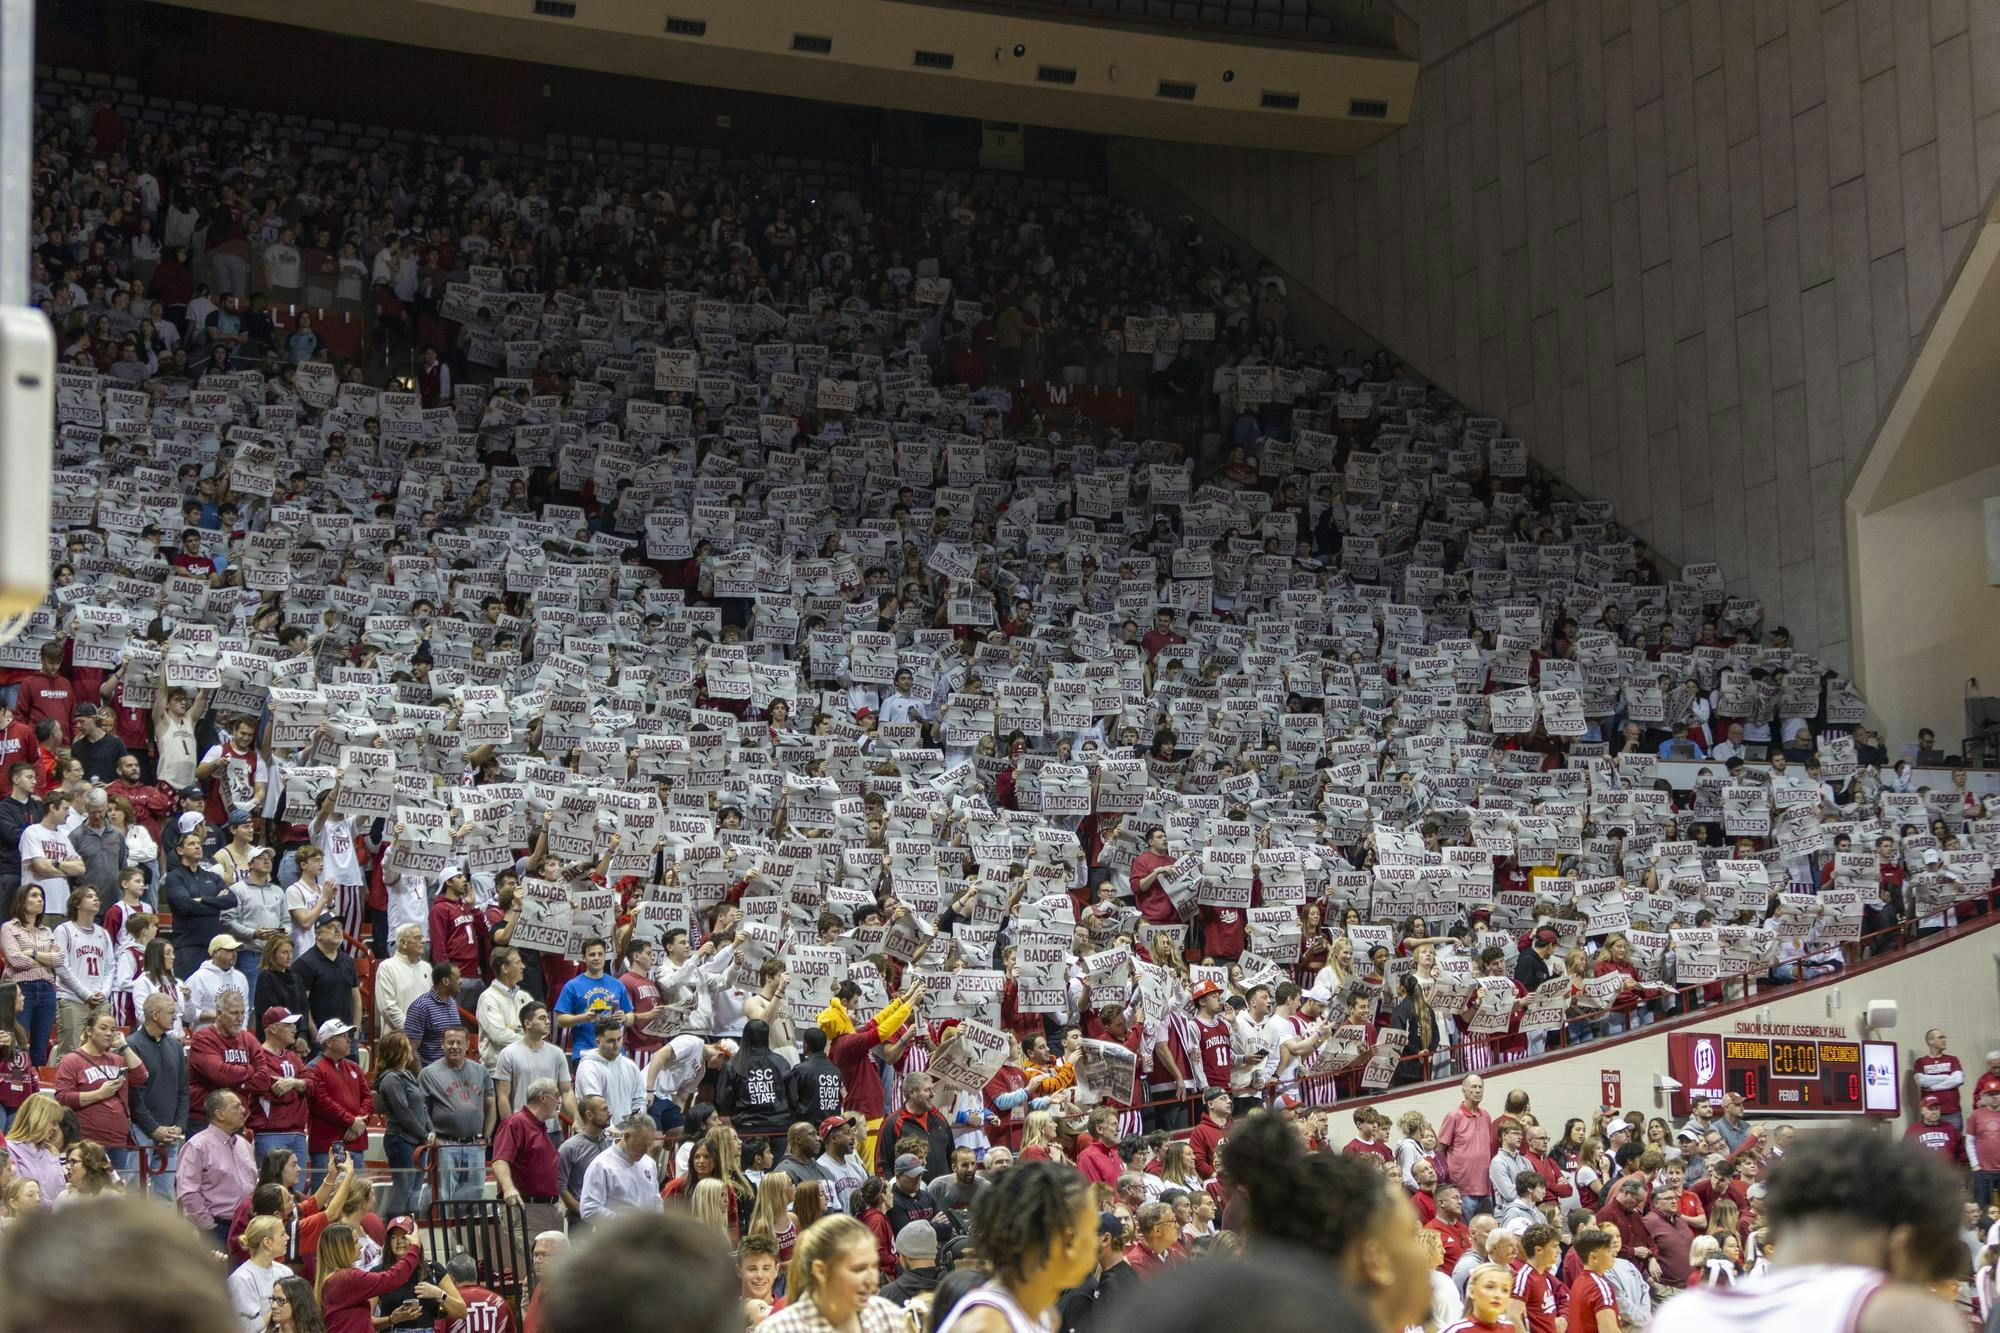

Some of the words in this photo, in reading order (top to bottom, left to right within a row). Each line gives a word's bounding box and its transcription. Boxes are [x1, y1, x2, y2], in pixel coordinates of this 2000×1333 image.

[1050, 387, 1067, 403] M
[651, 517, 684, 527] BADGER
[797, 566, 828, 577] BADGER
[117, 582, 155, 597] BADGER
[292, 588, 325, 600] BADGER
[334, 591, 368, 606] BADGER
[1287, 593, 1317, 603] BADGER
[83, 610, 123, 624] BADGER
[542, 610, 575, 623] BADGER
[682, 610, 715, 622] BADGER
[372, 619, 410, 631] BADGER
[857, 635, 891, 645] BADGER
[711, 648, 743, 660] BADGER
[231, 656, 268, 672] BADGER
[169, 666, 217, 681] BADGERS
[854, 666, 894, 678] BADGERS
[710, 681, 749, 693] BADGERS
[1004, 685, 1038, 696] BADGER
[1054, 682, 1086, 694] BADGER
[551, 701, 586, 713] BADGER
[955, 698, 989, 708] BADGER
[404, 708, 441, 720] BADGER
[1001, 718, 1041, 730] BADGERS
[1052, 714, 1090, 727] BADGERS
[1285, 717, 1318, 727] BADGER
[884, 726, 915, 737] BADGER
[587, 740, 621, 752] BADGER
[645, 739, 682, 750] BADGER
[350, 751, 389, 766] BADGER
[901, 752, 937, 761] BADGER
[1107, 762, 1141, 772] BADGER
[525, 767, 565, 784] BADGER
[938, 765, 974, 785] BADGER
[1438, 777, 1469, 788] BADGER
[674, 793, 704, 807] BADGER
[1729, 789, 1762, 800] BADGER
[338, 793, 390, 811] BADGERS
[561, 797, 596, 813] BADGER
[1045, 797, 1088, 809] BADGERS
[1329, 797, 1362, 808] BADGER
[789, 807, 834, 823] BADGERS
[894, 807, 926, 819] BADGER
[406, 811, 443, 828] BADGER
[624, 813, 654, 828] BADGER
[1727, 819, 1767, 831] BADGERS
[670, 820, 706, 833] BADGER
[1218, 825, 1249, 836] BADGER
[1039, 832, 1073, 843] BADGER
[550, 836, 592, 855] BADGERS
[897, 843, 931, 855] BADGER
[1660, 844, 1693, 856] BADGER
[684, 847, 720, 860] BADGER
[778, 846, 812, 859] BADGER
[1210, 852, 1246, 864] BADGER
[1259, 852, 1296, 863] BADGER
[1450, 851, 1486, 863] BADGER
[1950, 852, 1984, 864] BADGER
[394, 853, 445, 872] BADGERS
[1842, 855, 1874, 867] BADGER
[1381, 869, 1415, 880] BADGER
[1337, 876, 1367, 887] BADGER
[1541, 881, 1572, 892] BADGER
[1582, 879, 1616, 894] BADGER
[831, 890, 868, 903] BADGER
[1201, 888, 1248, 902] BADGERS
[1500, 894, 1536, 908] BADGER
[1824, 893, 1856, 904] BADGER
[581, 895, 612, 910] BADGER
[747, 901, 777, 916] BADGER
[1418, 901, 1455, 914] BADGERS
[645, 907, 682, 921] BADGER
[1255, 911, 1292, 922] BADGER
[465, 925, 474, 944] 1
[514, 925, 567, 947] BADGERS
[1353, 929, 1387, 940] BADGER
[1679, 932, 1713, 942] BADGER
[1024, 950, 1062, 962] BADGER
[1092, 951, 1126, 970] BADGER
[87, 957, 99, 976] 11
[792, 960, 829, 977] BADGER
[1678, 965, 1717, 978] BADGERS
[1018, 990, 1065, 1005] BADGERS
[1523, 1008, 1562, 1025] BADGERS
[1737, 1022, 1761, 1034] SIMON
[1763, 1024, 1789, 1036] SKJODT
[1792, 1025, 1827, 1037] ASSEMBLY
[1829, 1027, 1845, 1038] HALL
[967, 1025, 1004, 1050] BADGER
[1216, 1047, 1228, 1066] 11
[1727, 1042, 1768, 1059] INDIANA
[1774, 1045, 1816, 1072] 20:00
[819, 1075, 839, 1086] CSC
[1746, 1071, 1755, 1099] 0
[748, 1081, 773, 1093] EVENT
[820, 1087, 839, 1098] EVENT
[1850, 1074, 1858, 1100] 0
[751, 1093, 776, 1104] STAFF
[1608, 1084, 1615, 1103] 9
[1779, 1090, 1799, 1101] PERIOD
[1804, 1086, 1808, 1101] 1
